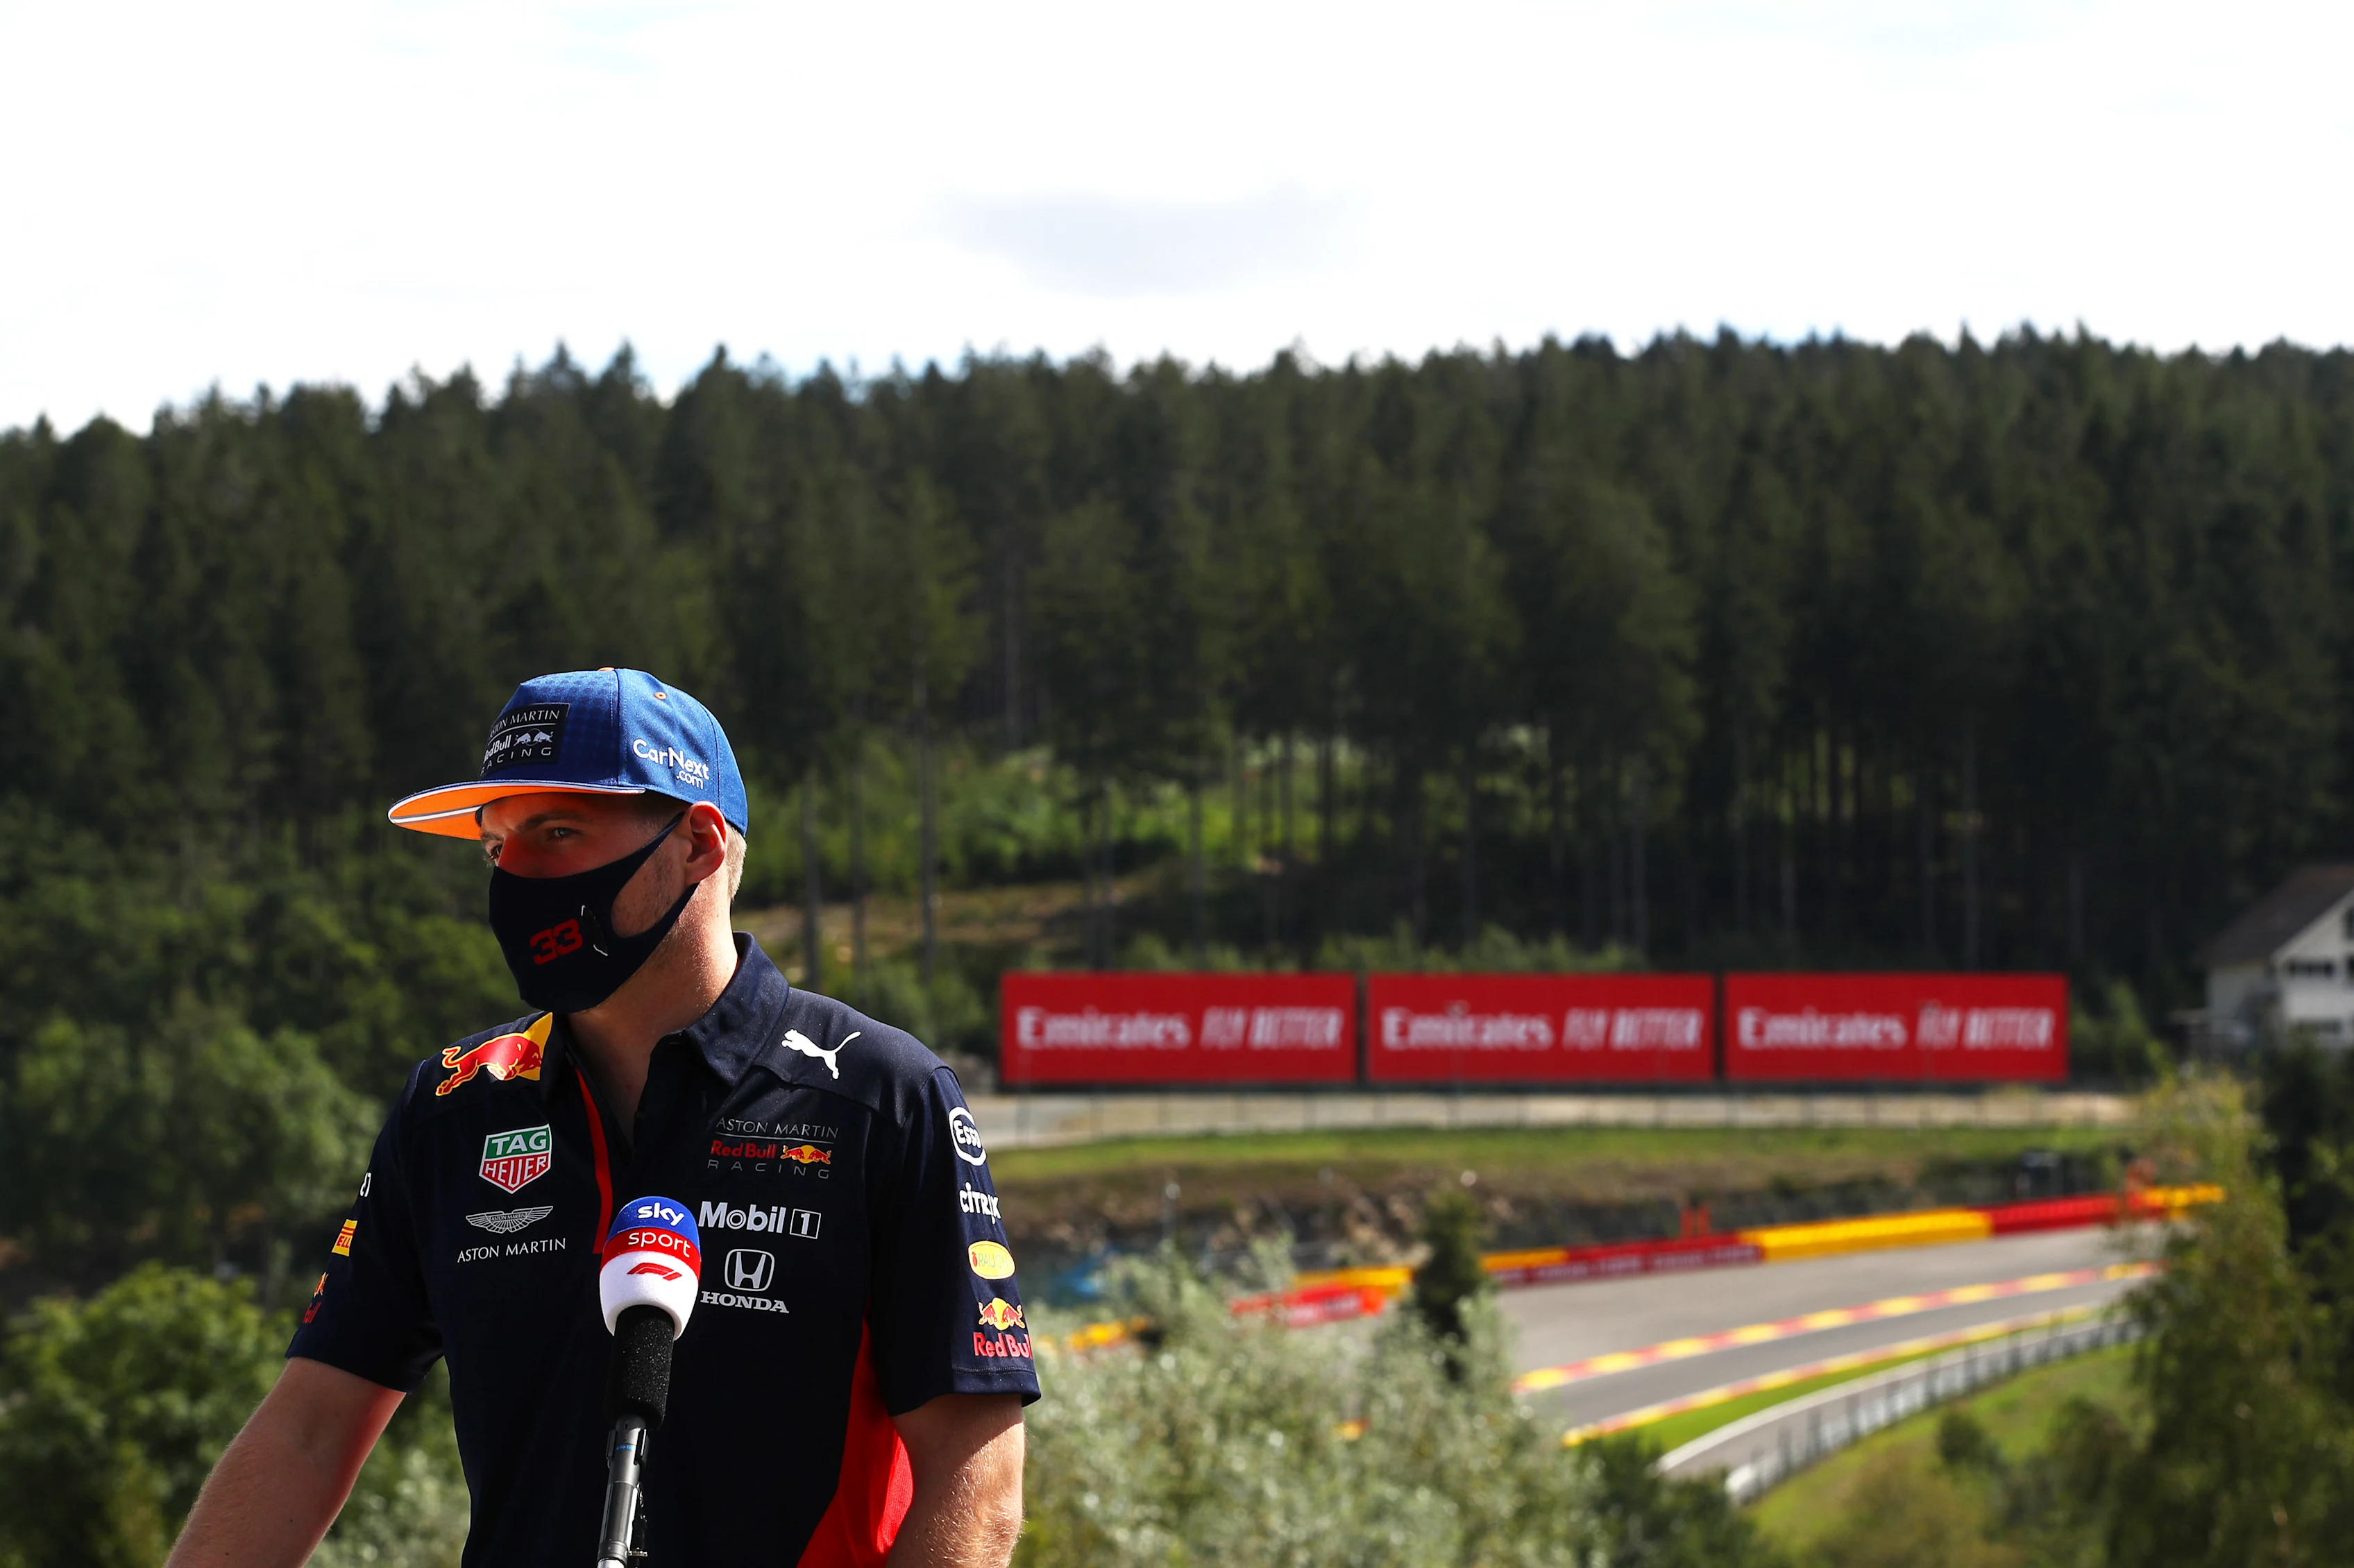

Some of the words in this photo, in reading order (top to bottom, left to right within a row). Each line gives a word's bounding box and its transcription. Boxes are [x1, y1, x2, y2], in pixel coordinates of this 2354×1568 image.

[510, 710, 560, 725] MARTIN
[633, 739, 710, 781] CarNext
[676, 770, 704, 790] .com
[530, 919, 583, 965] 33
[1017, 1005, 1190, 1050] Emirates
[1382, 1005, 1554, 1050] Emirates
[1737, 1005, 1908, 1050] Emirates
[715, 1116, 768, 1133] ASTON
[774, 1123, 838, 1139] MARTIN
[491, 1131, 547, 1156] TAG
[485, 1155, 547, 1188] HEUER
[707, 1159, 830, 1179] RACING
[637, 1202, 685, 1227] sky
[698, 1200, 787, 1234] Mobil
[800, 1212, 811, 1236] 1
[457, 1245, 500, 1263] ASTON
[505, 1237, 566, 1256] MARTIN
[627, 1232, 691, 1258] sport
[700, 1290, 790, 1314] HONDA
[973, 1331, 1008, 1358] Red
[1004, 1333, 1033, 1360] Bul
